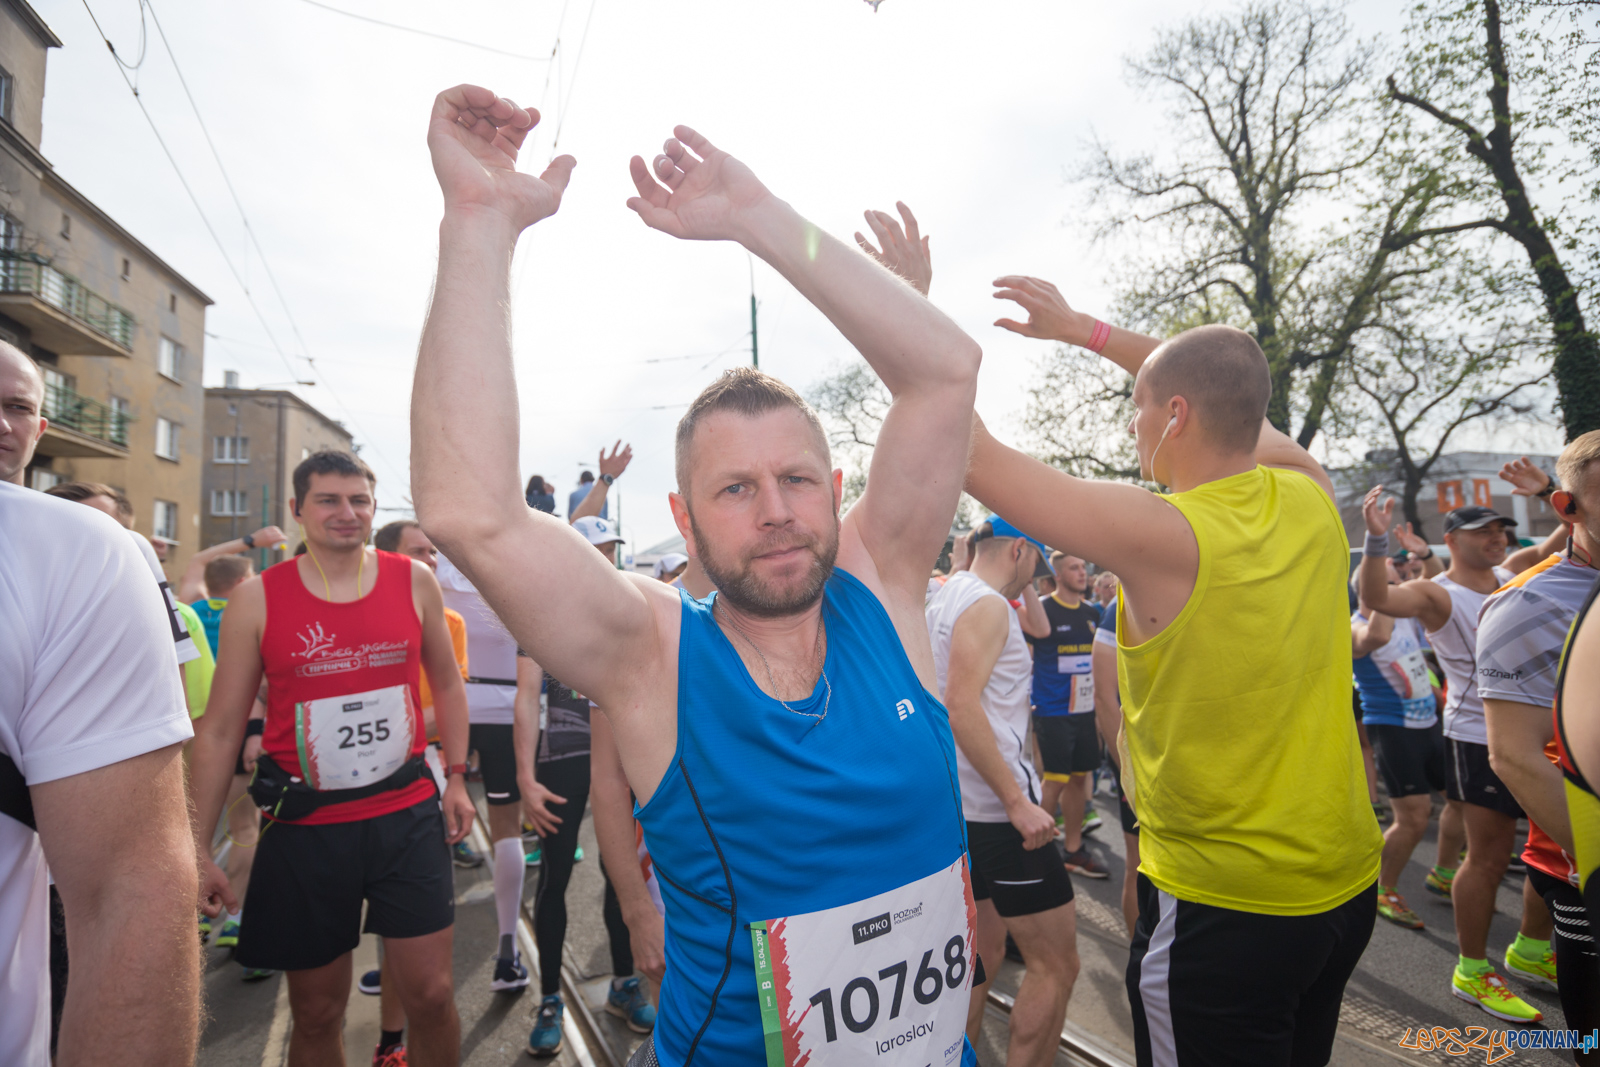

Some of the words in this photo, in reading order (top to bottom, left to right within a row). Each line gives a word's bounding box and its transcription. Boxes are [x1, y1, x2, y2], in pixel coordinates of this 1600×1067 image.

[337, 718, 391, 750] 255
[357, 749, 377, 758] Piotr
[858, 927, 869, 937] 11.
[869, 919, 888, 934] PKO
[762, 980, 772, 990] B
[809, 934, 967, 1043] 10768
[875, 1020, 935, 1056] Iaroslav
